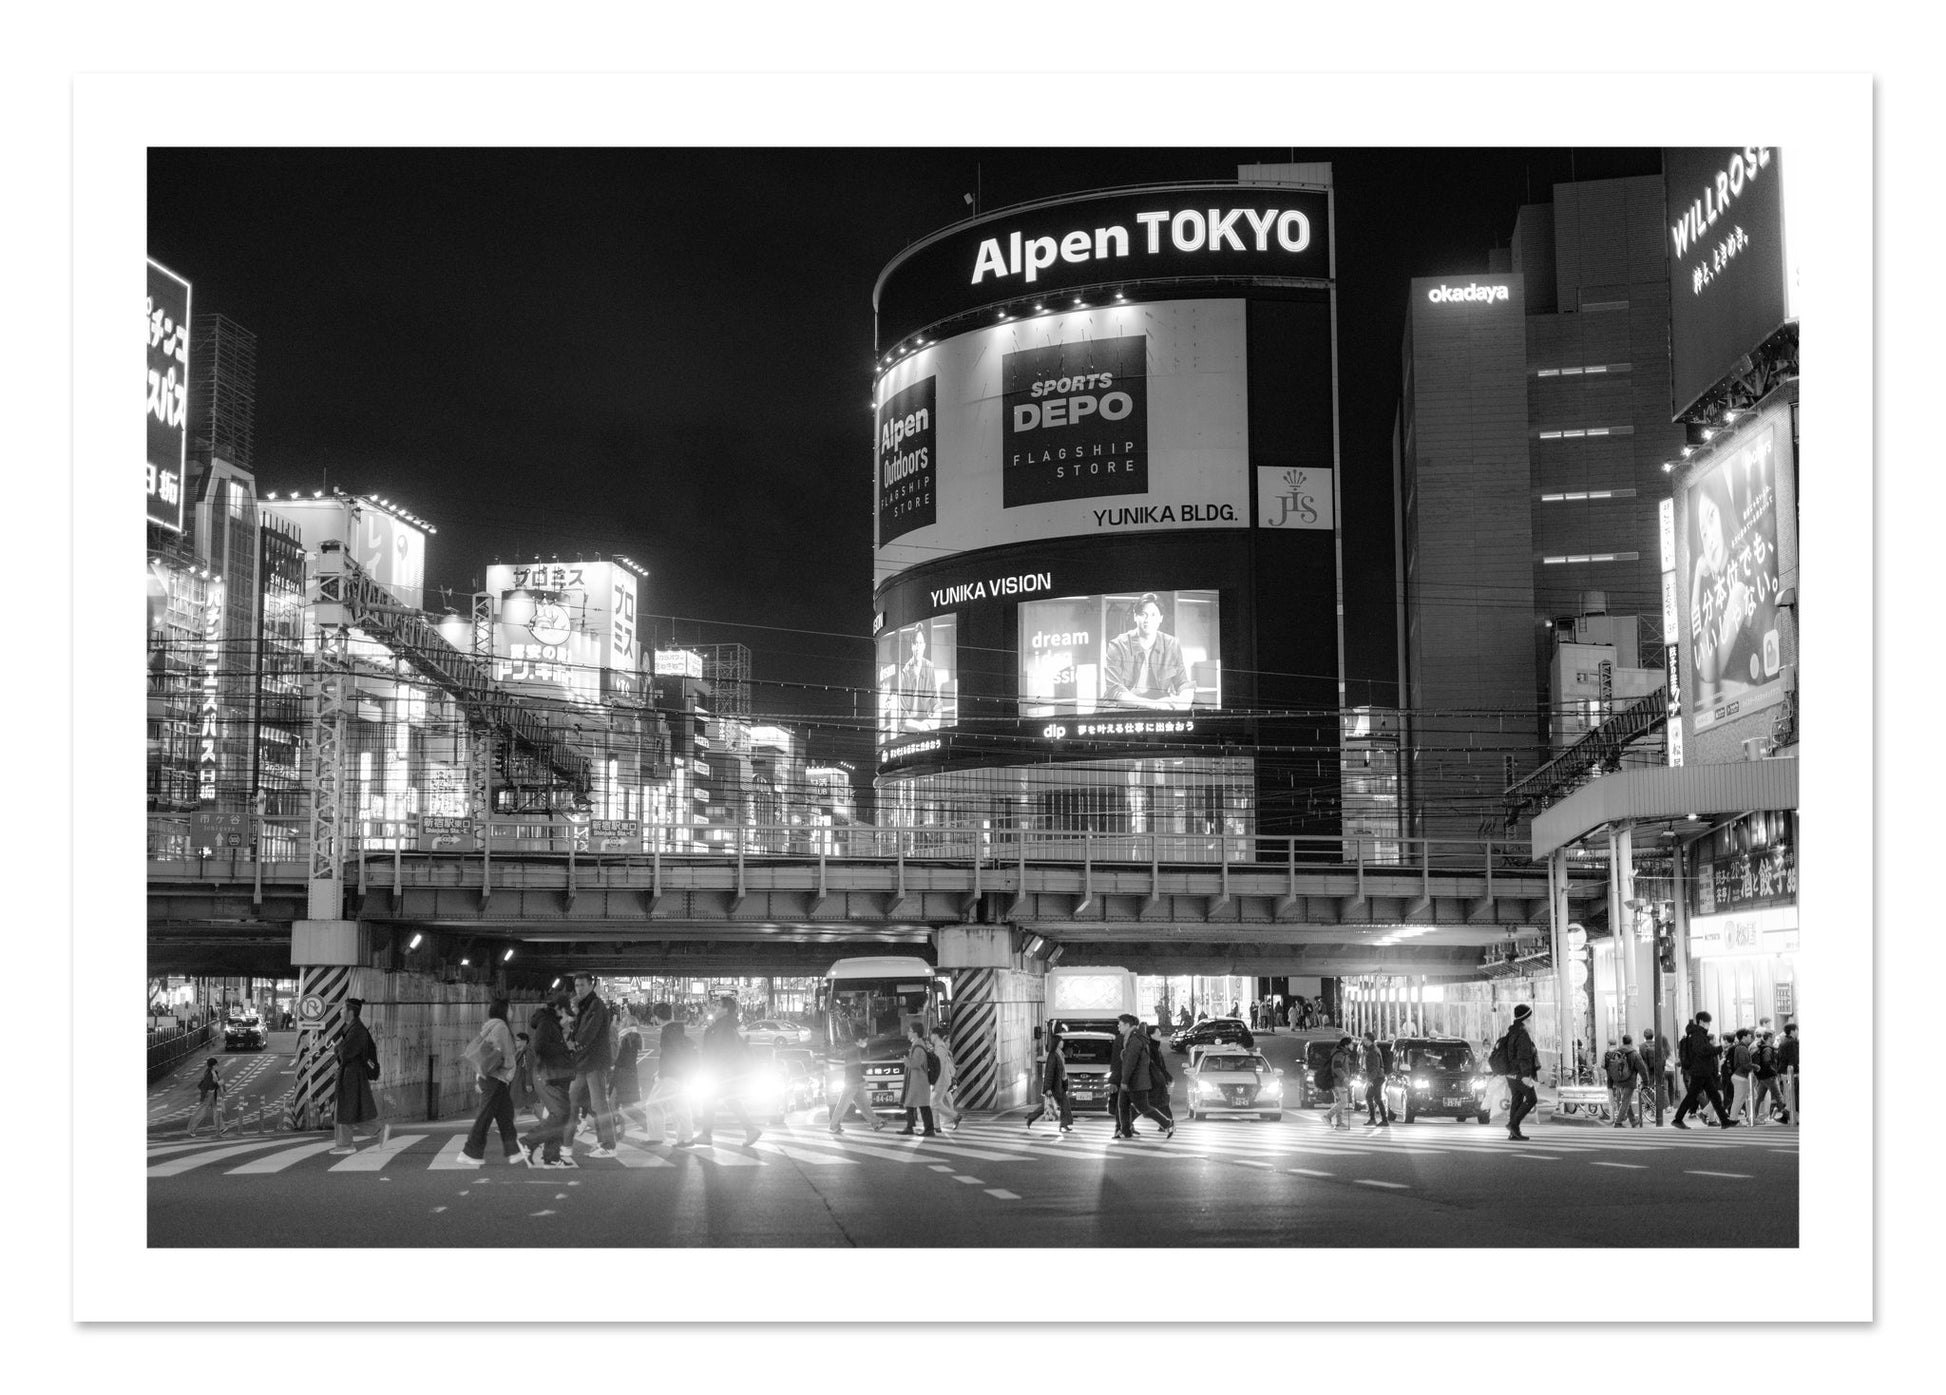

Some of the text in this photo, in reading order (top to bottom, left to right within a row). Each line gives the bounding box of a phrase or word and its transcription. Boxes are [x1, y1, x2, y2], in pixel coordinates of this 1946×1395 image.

[971, 208, 1311, 285] Alpen TOKYO
[1428, 282, 1509, 304] okadaya
[1031, 372, 1113, 398] SPORTS
[1013, 391, 1134, 433] DEPO
[881, 408, 929, 455] Alpen
[1013, 441, 1134, 467] FLAGSHIP
[884, 446, 929, 489] Outdoors
[1056, 460, 1135, 478] STORE
[881, 476, 930, 510] FLAGSHIP
[894, 493, 930, 518] STORE
[1093, 503, 1239, 527] YUNIKA BLDG.
[270, 573, 300, 595] SHISHA
[513, 567, 585, 588] プロミス
[930, 572, 1051, 608] YUNIKA VISION
[1691, 532, 1775, 640] 自分本位でも、
[1693, 571, 1778, 671] いいじゃない。
[1032, 631, 1089, 648] dream
[1043, 721, 1194, 739] dip 夢を叶える仕事に出会おう
